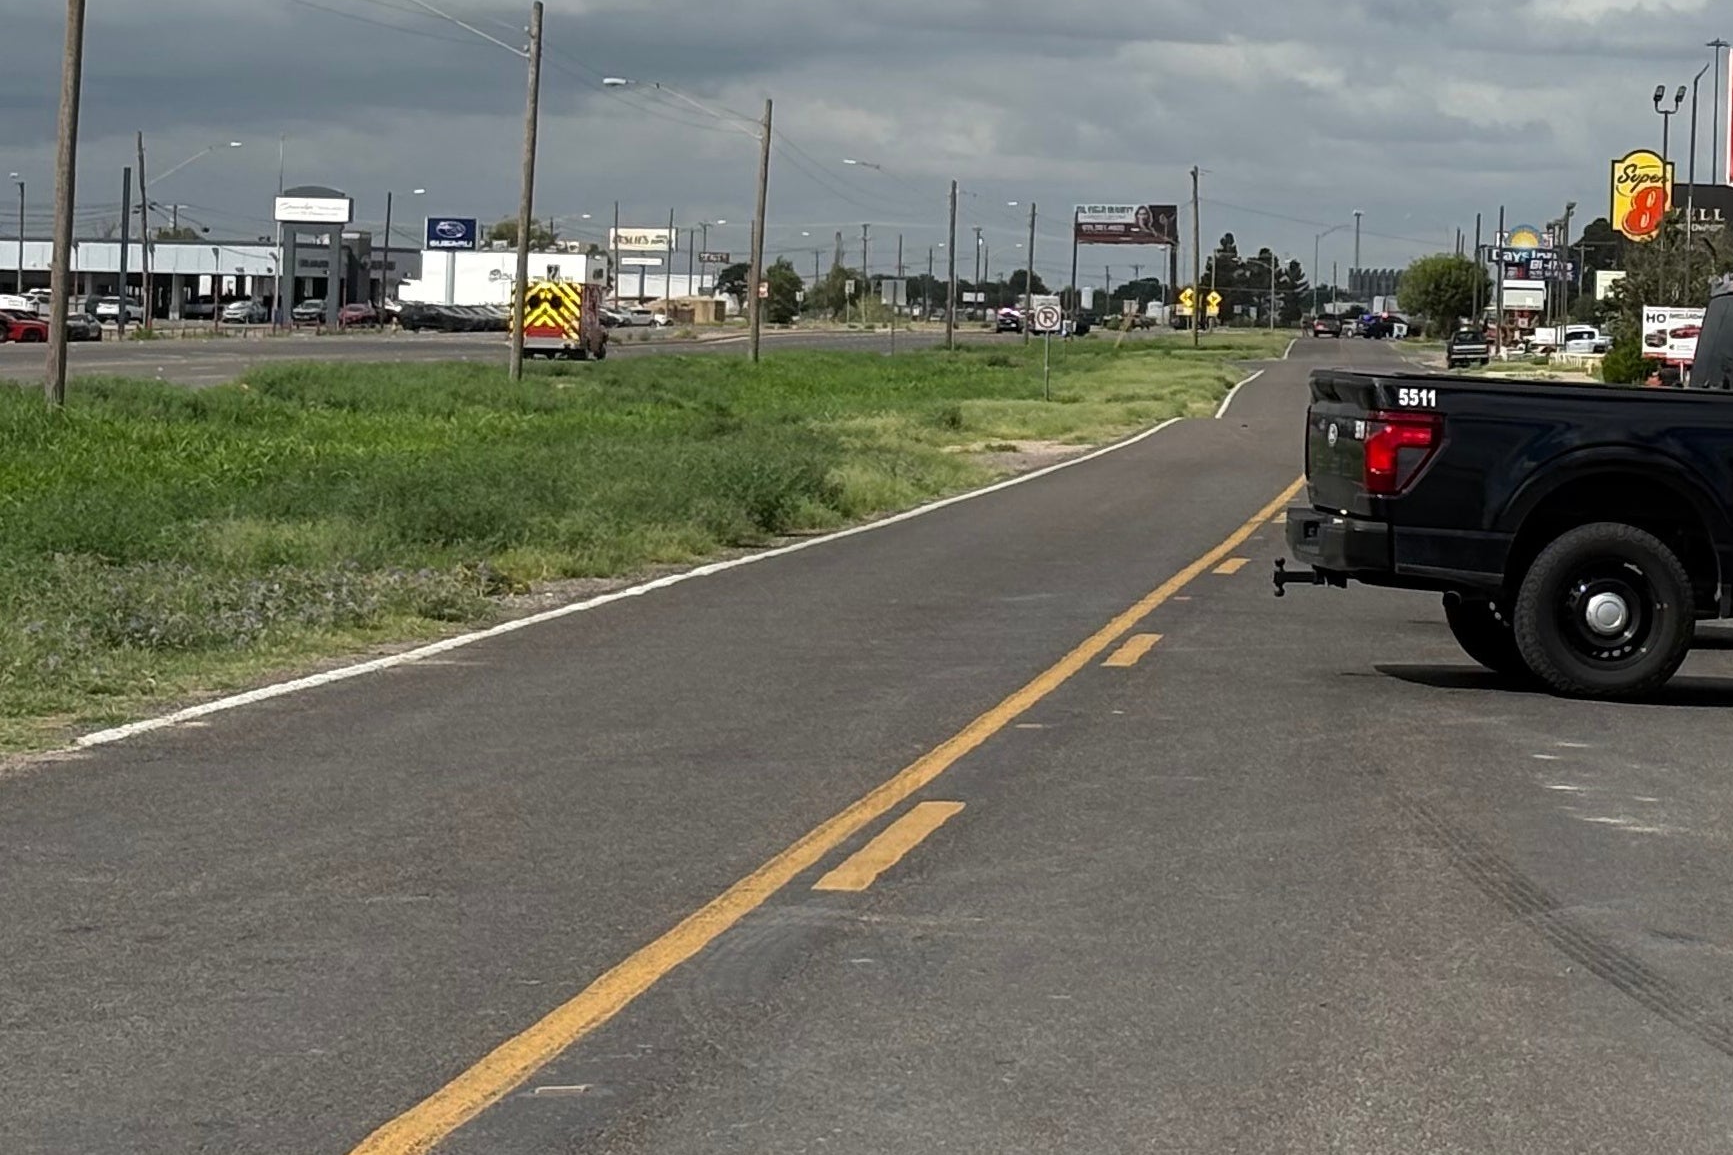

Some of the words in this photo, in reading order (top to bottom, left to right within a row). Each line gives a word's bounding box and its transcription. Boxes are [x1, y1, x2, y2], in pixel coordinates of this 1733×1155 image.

[1617, 163, 1669, 194] Super
[1621, 186, 1669, 236] 8
[1399, 388, 1436, 407] 5511
